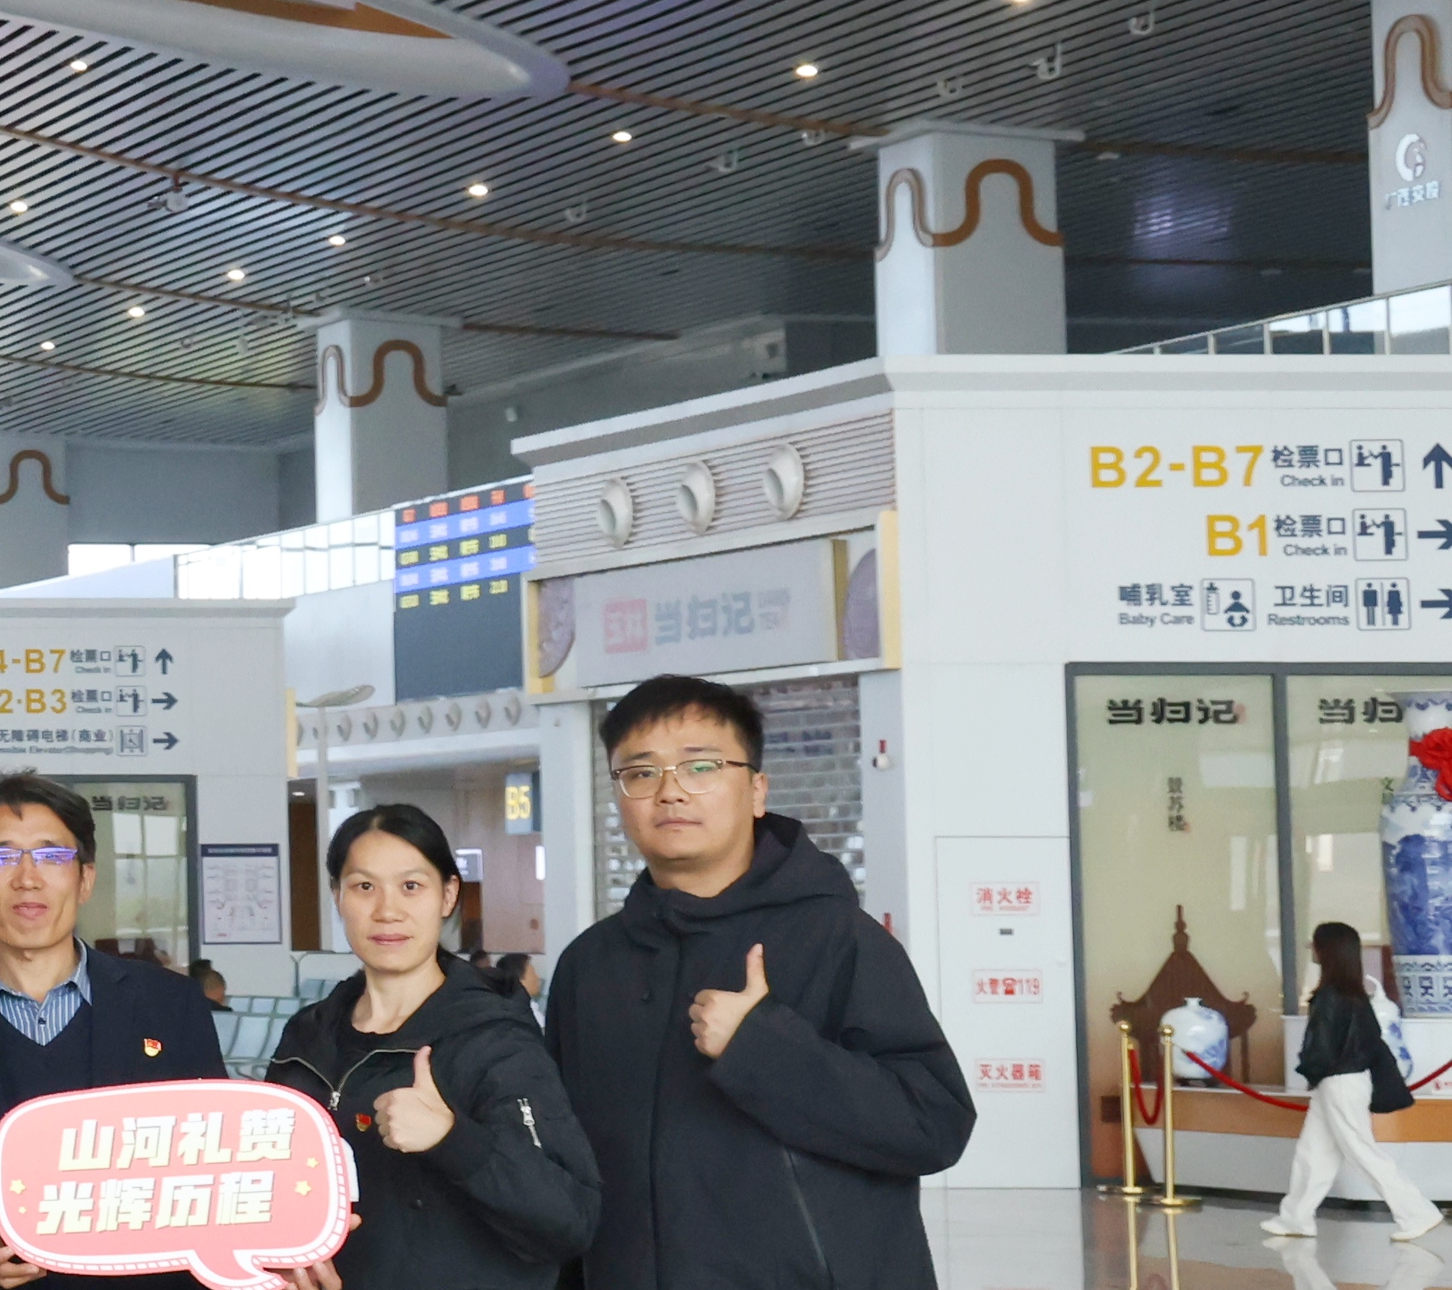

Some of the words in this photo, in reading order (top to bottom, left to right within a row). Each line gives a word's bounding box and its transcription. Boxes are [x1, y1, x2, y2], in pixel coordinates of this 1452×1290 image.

[1090, 445, 1263, 488] B2-B7
[1271, 445, 1344, 468] 检票口
[1280, 475, 1328, 487] Check
[1331, 475, 1344, 487] in
[1206, 514, 1268, 557] B1
[1274, 514, 1346, 538] 检票口
[1283, 543, 1330, 557] Check
[1334, 543, 1347, 556] in
[1118, 582, 1194, 607] 哺乳室
[1274, 583, 1349, 607] 卫生间
[1118, 613, 1157, 628] Baby
[1159, 613, 1194, 625] Care
[1267, 613, 1349, 626] Restrooms
[70, 649, 111, 663] 检票口
[71, 689, 112, 702] 检票口
[1107, 697, 1239, 725] 当归记
[1318, 697, 1404, 725] 当归
[505, 785, 531, 820] B5
[976, 887, 1032, 904] 消火栓
[979, 1064, 1042, 1081] 灭火器箱
[58, 1107, 296, 1172] 山河礼赞
[35, 1170, 275, 1235] 光辉历程
